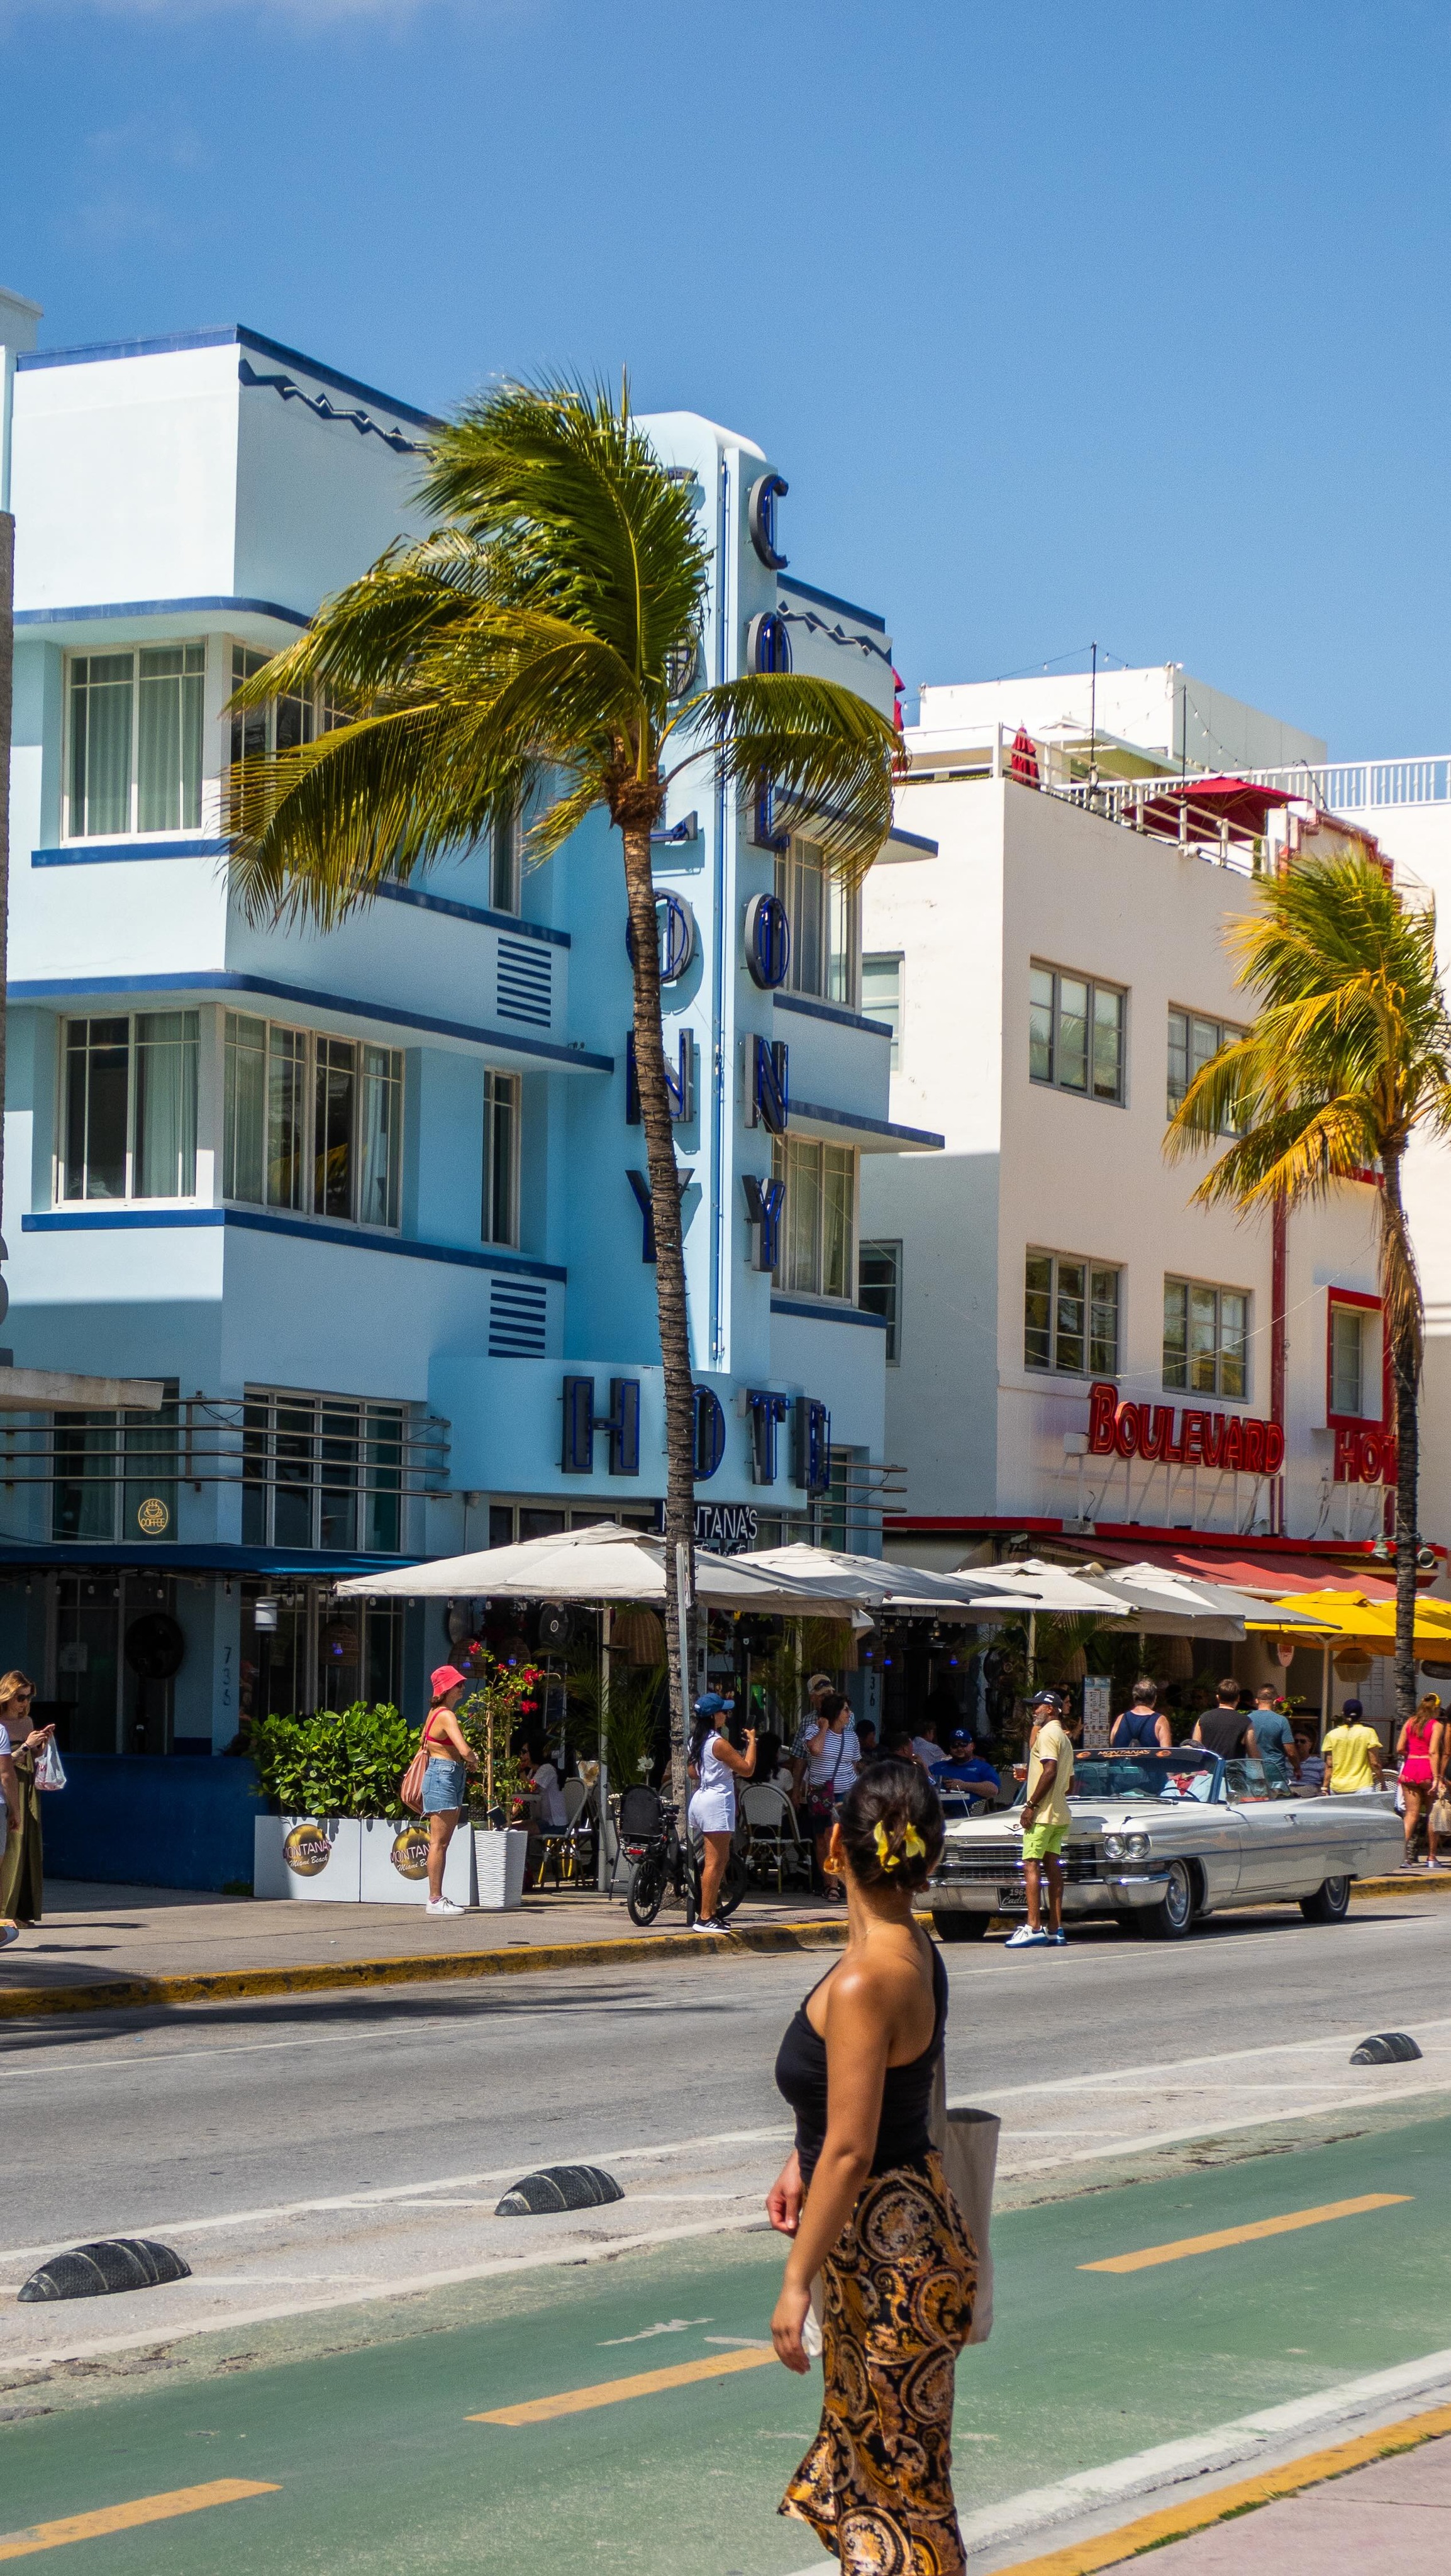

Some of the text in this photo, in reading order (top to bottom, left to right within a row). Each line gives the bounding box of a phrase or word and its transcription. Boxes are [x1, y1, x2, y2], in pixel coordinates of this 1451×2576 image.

[1089, 1382, 1399, 1487] BOULEVARD HOT
[141, 1518, 165, 1527] COFFEE
[389, 1843, 431, 1863] MONTAN
[289, 1853, 328, 1867] Miami Beach
[397, 1862, 419, 1872] Miami
[1009, 1888, 1026, 1896] 196
[1001, 1896, 1028, 1906] Cadil
